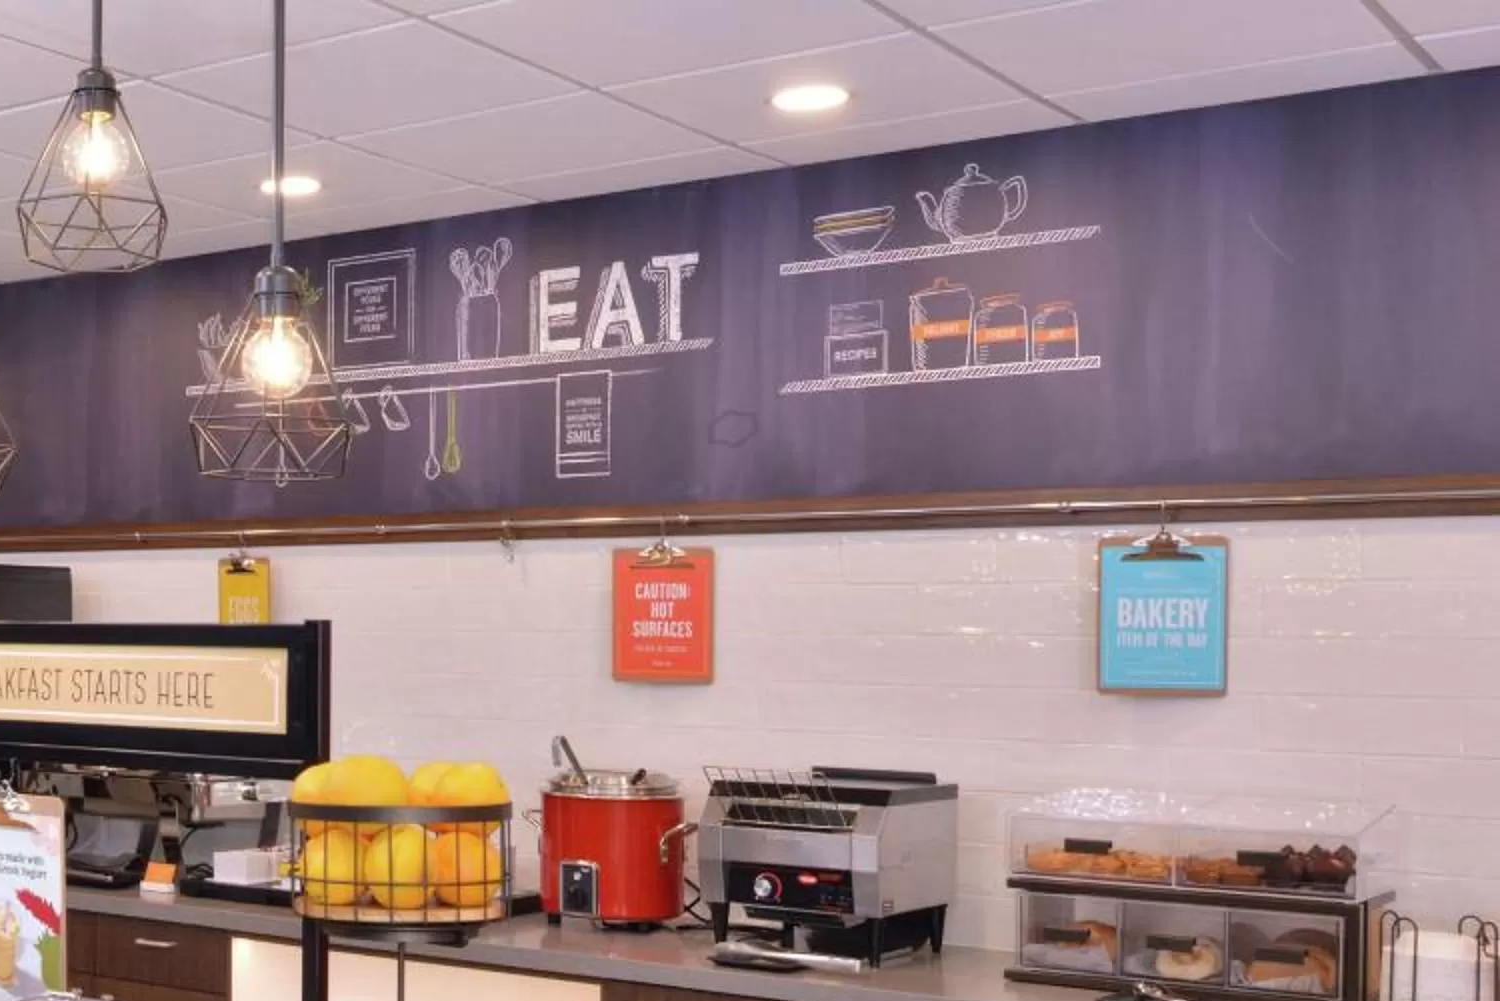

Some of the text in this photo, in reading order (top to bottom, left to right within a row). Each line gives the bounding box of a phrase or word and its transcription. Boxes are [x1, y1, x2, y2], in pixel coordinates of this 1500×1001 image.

[531, 252, 699, 352] EAT
[565, 429, 602, 444] SMILE
[649, 601, 675, 619] HOT
[1117, 597, 1208, 629] BAKERY
[631, 620, 694, 638] SURFACES
[71, 668, 147, 706] STARTS
[157, 671, 215, 709] HERE
